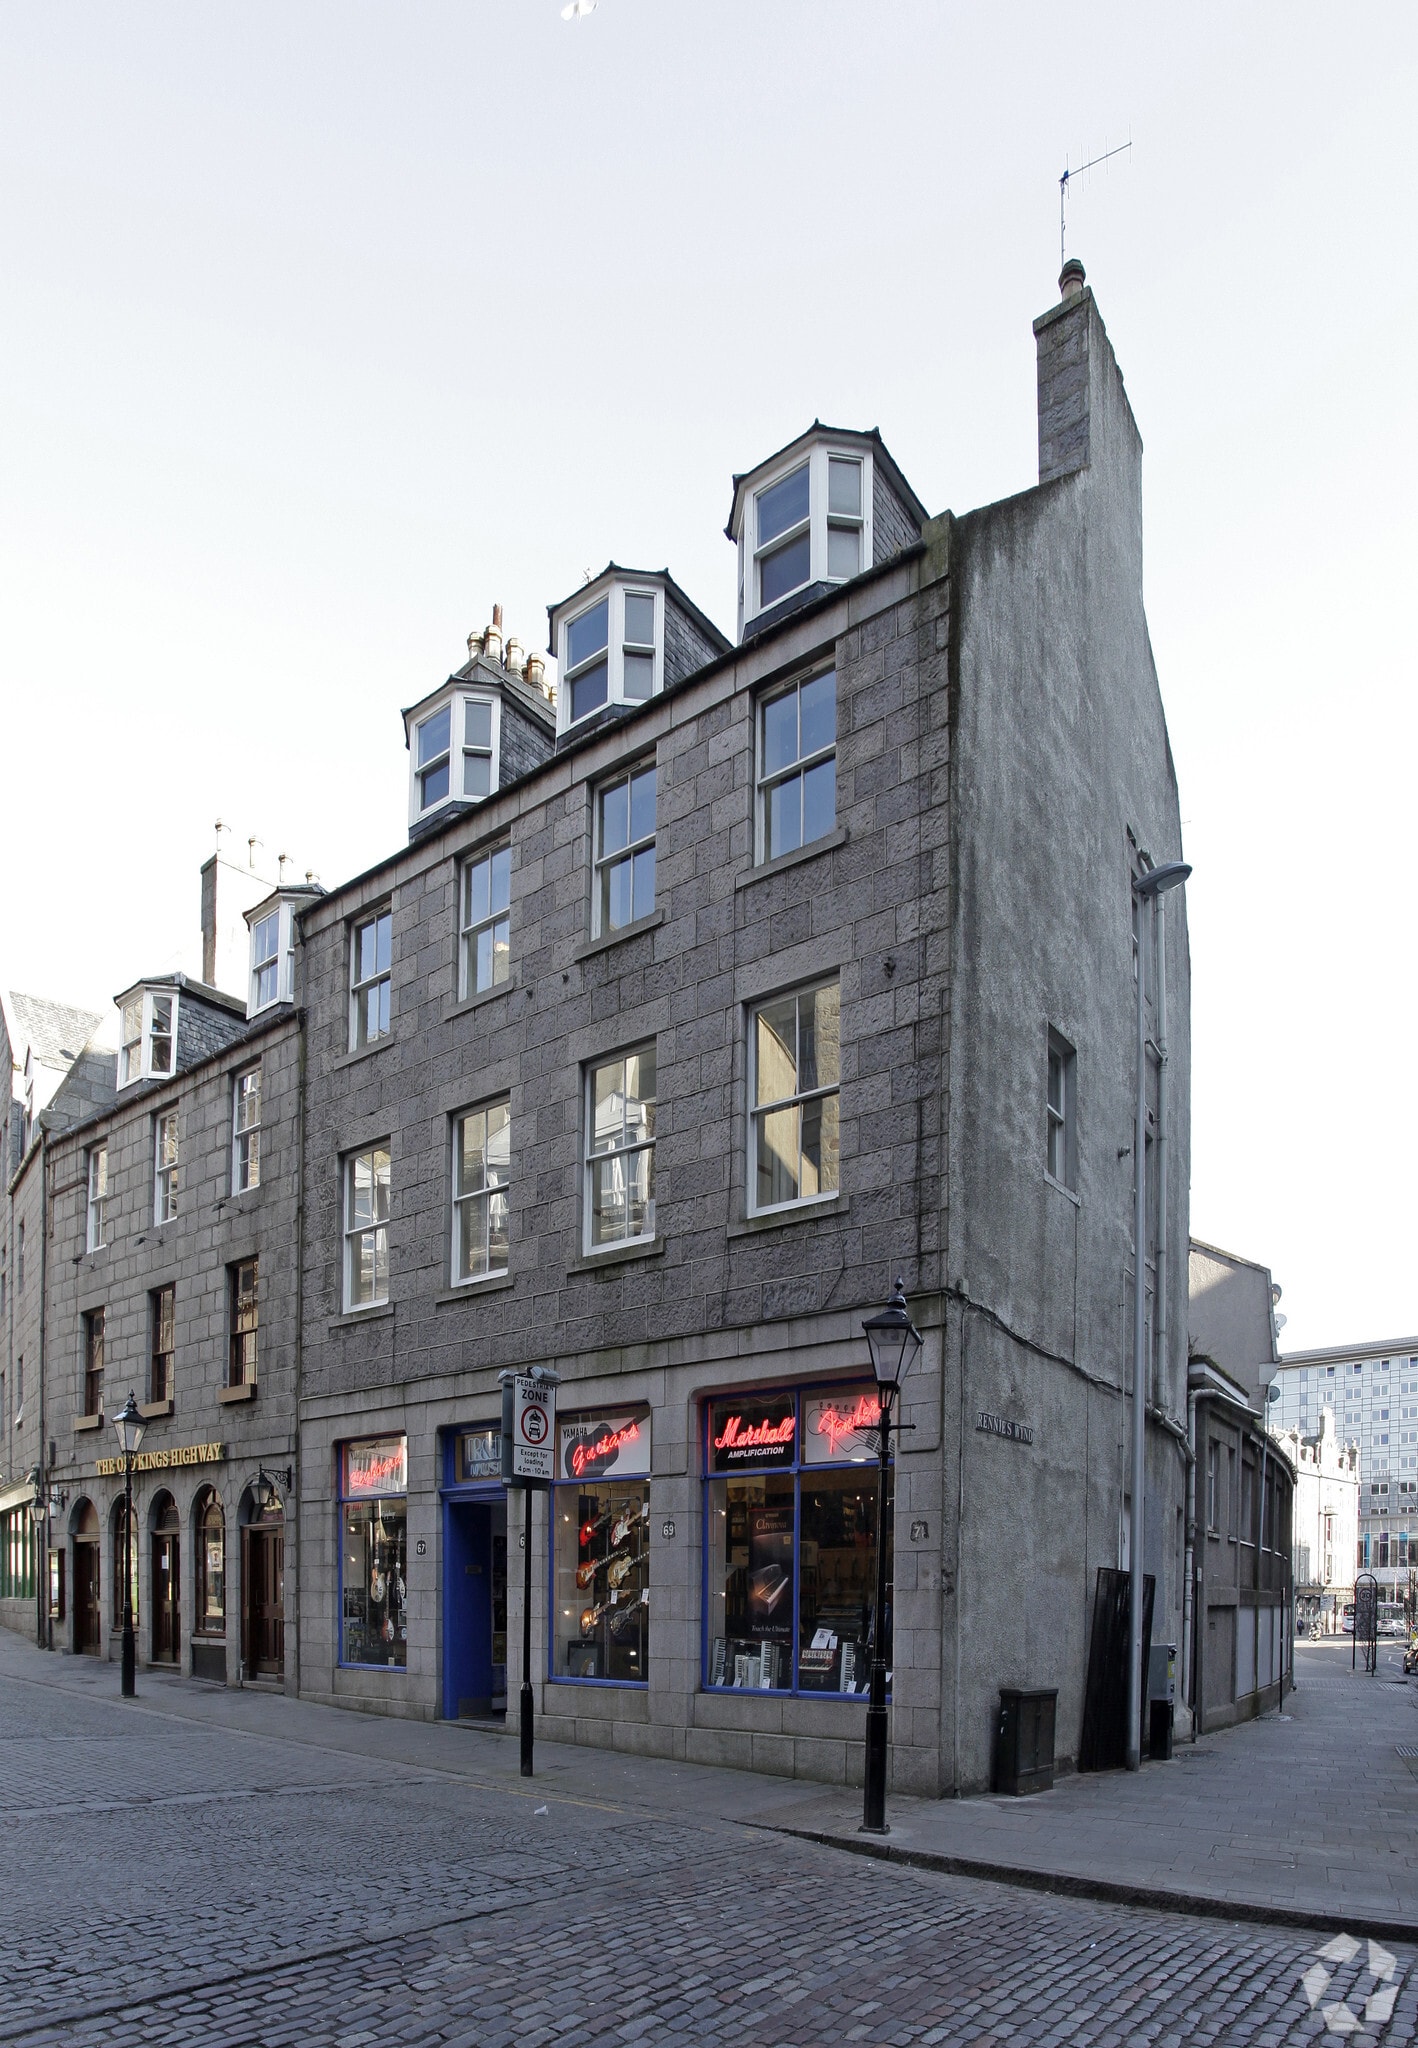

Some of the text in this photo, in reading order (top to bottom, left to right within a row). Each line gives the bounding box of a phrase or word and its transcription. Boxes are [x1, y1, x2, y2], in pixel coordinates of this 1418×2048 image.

[521, 1389, 548, 1403] ZONE
[818, 1396, 882, 1455] Fender
[562, 1427, 588, 1439] YAMAHA
[715, 1416, 796, 1449] Marshall
[520, 1449, 539, 1458] Except
[572, 1424, 639, 1476] Guitars
[728, 1446, 784, 1459] AMPLIFICATION
[95, 1458, 115, 1475] THE
[137, 1450, 169, 1471] KINGS
[170, 1442, 222, 1466] HIGHWAY
[524, 1457, 544, 1467] loading
[663, 1525, 674, 1536] 69
[417, 1543, 425, 1553] 67
